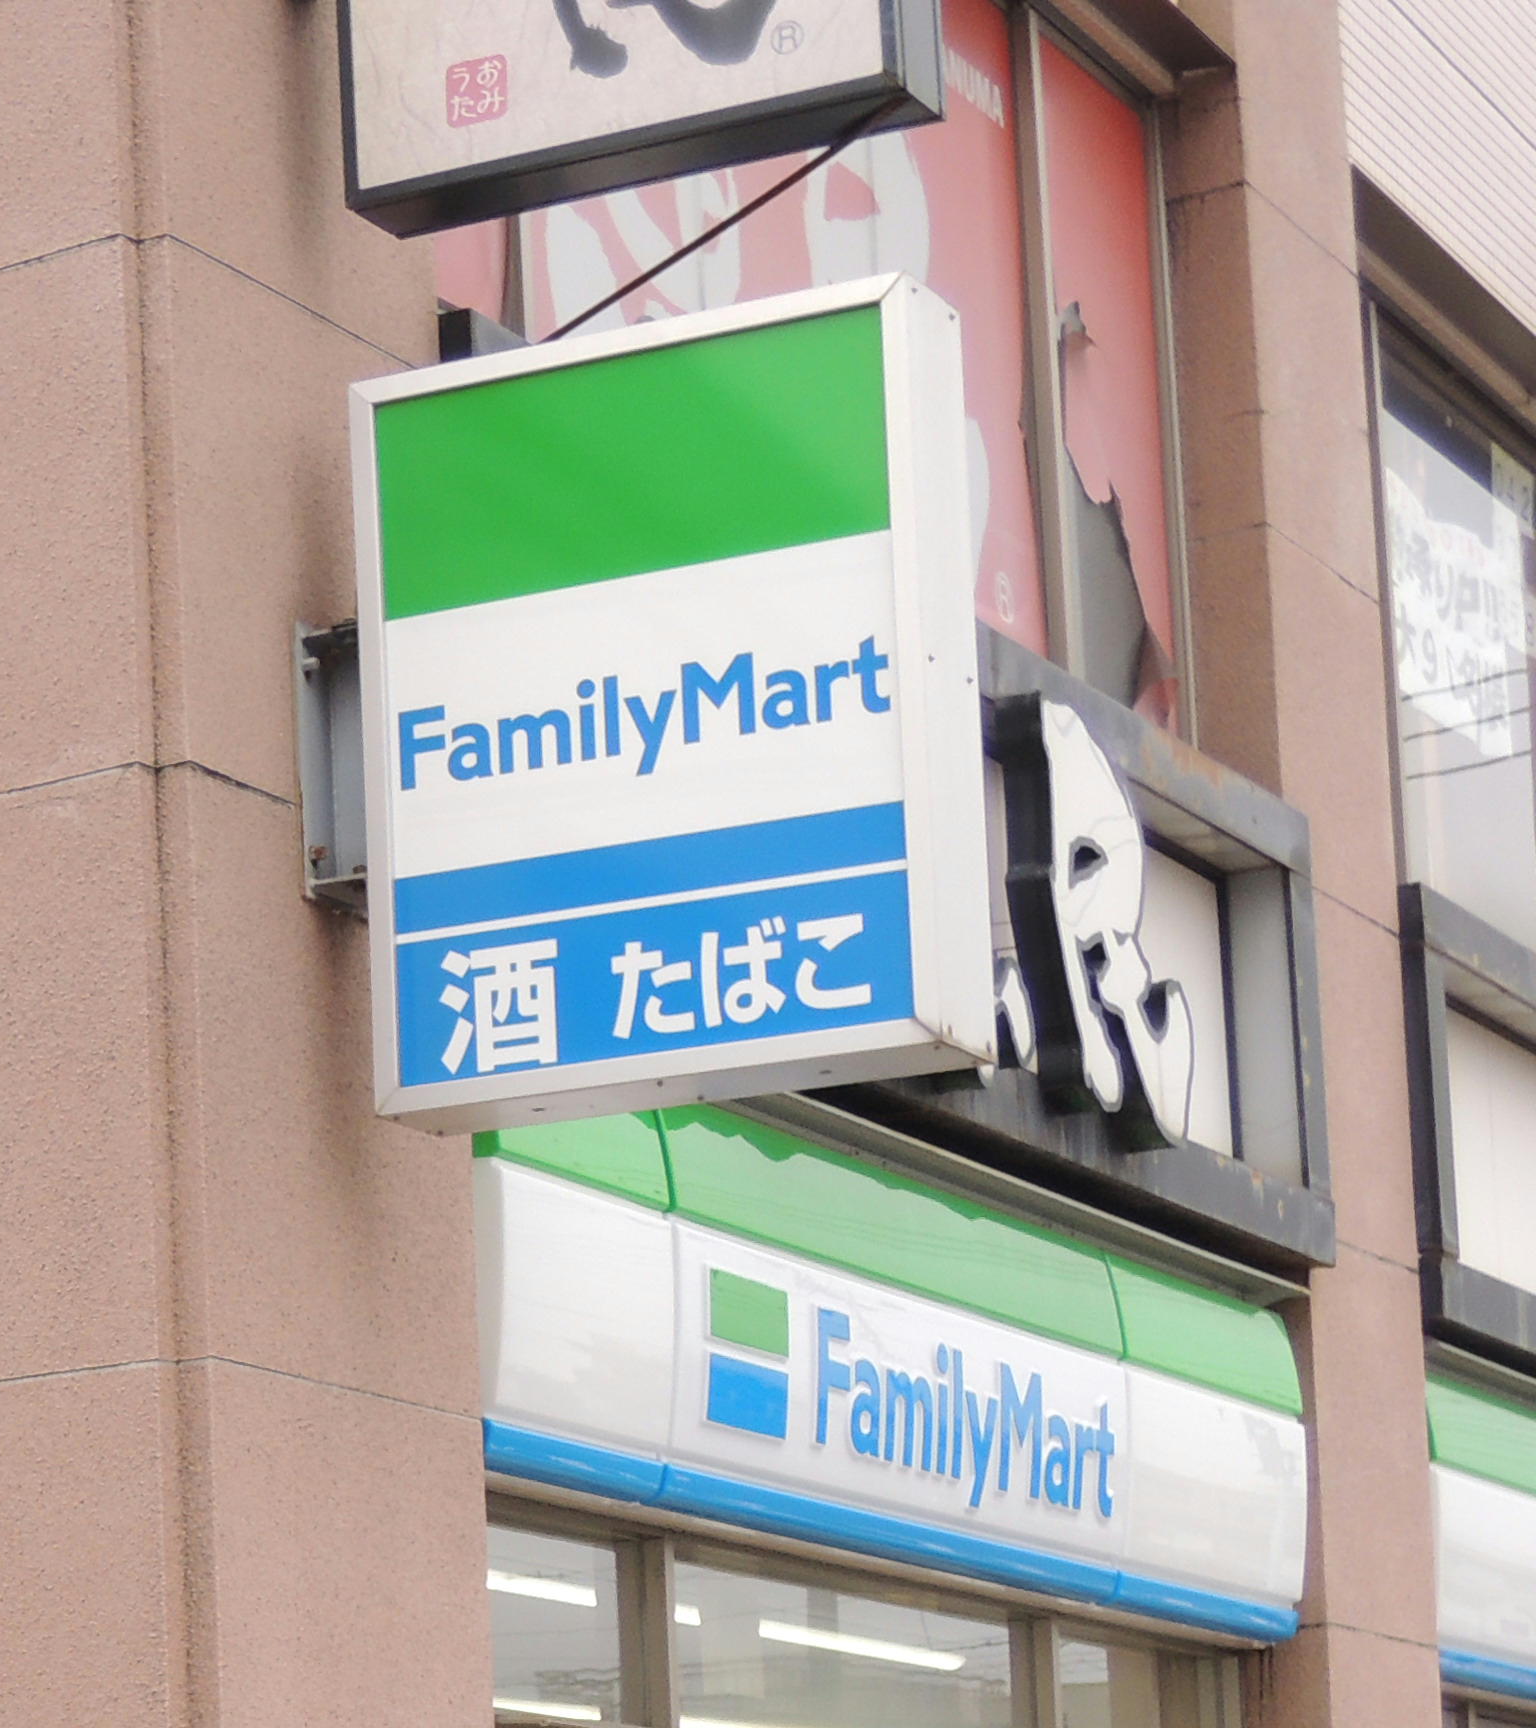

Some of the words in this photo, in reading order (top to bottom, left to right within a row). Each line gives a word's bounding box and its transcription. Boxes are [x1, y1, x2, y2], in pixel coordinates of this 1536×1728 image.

[944, 46, 1005, 129] NUMA
[398, 636, 890, 791] FamilyMart
[439, 938, 559, 1074] 酒
[611, 913, 872, 1040] たばこ
[994, 697, 1195, 1141] 民
[816, 1307, 1115, 1518] FamilyMart
